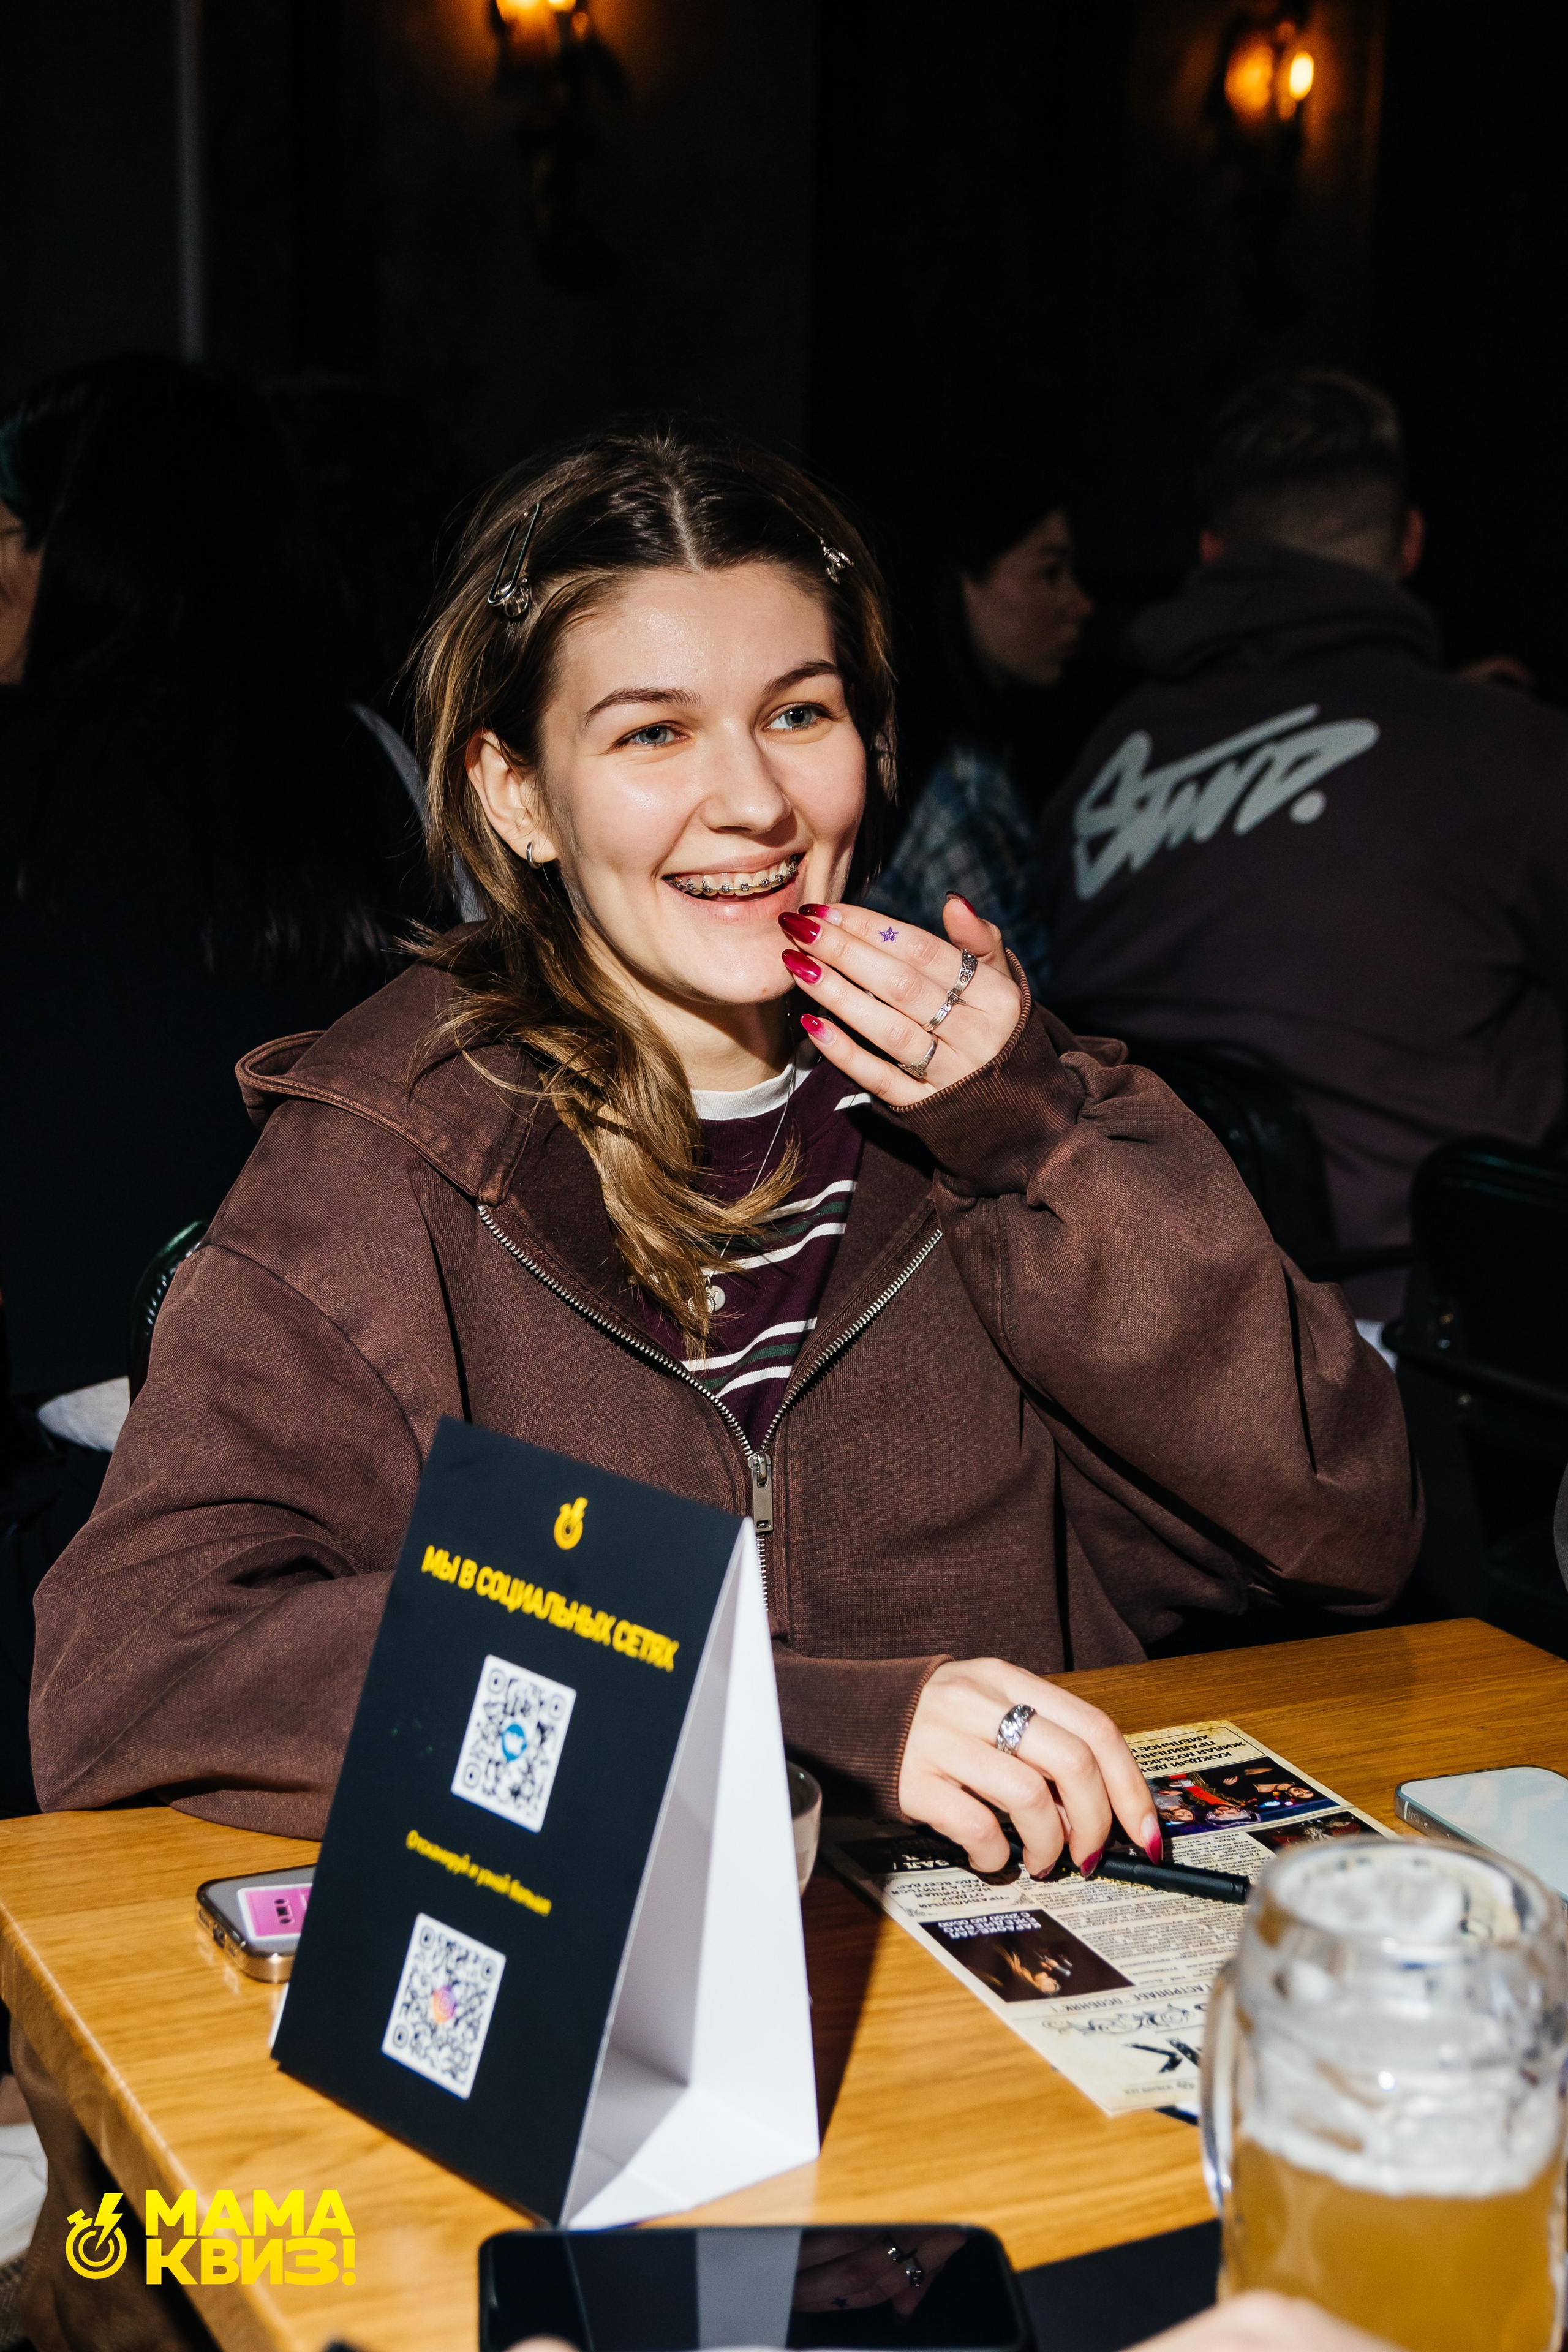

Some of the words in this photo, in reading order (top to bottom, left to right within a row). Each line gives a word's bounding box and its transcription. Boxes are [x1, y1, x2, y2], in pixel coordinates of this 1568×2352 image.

[421, 1544, 461, 1585] МЫ
[458, 1558, 478, 1589] В
[475, 1565, 617, 1646] СОЦИАЛЬНЫХ
[612, 1619, 680, 1673] СЕТЯХ
[1138, 1735, 1210, 1751] ХМЕЛЬНОЕ
[1196, 1741, 1245, 1754] ЖИВАЯ
[1139, 1763, 1169, 1772] ДЕН
[1170, 1752, 1232, 1767] КАЖДЫЙ
[941, 1917, 1037, 1933] ЕЖЕДНЕВНО
[949, 1922, 1042, 1939] КАРАОКЕ-ЗАЛ
